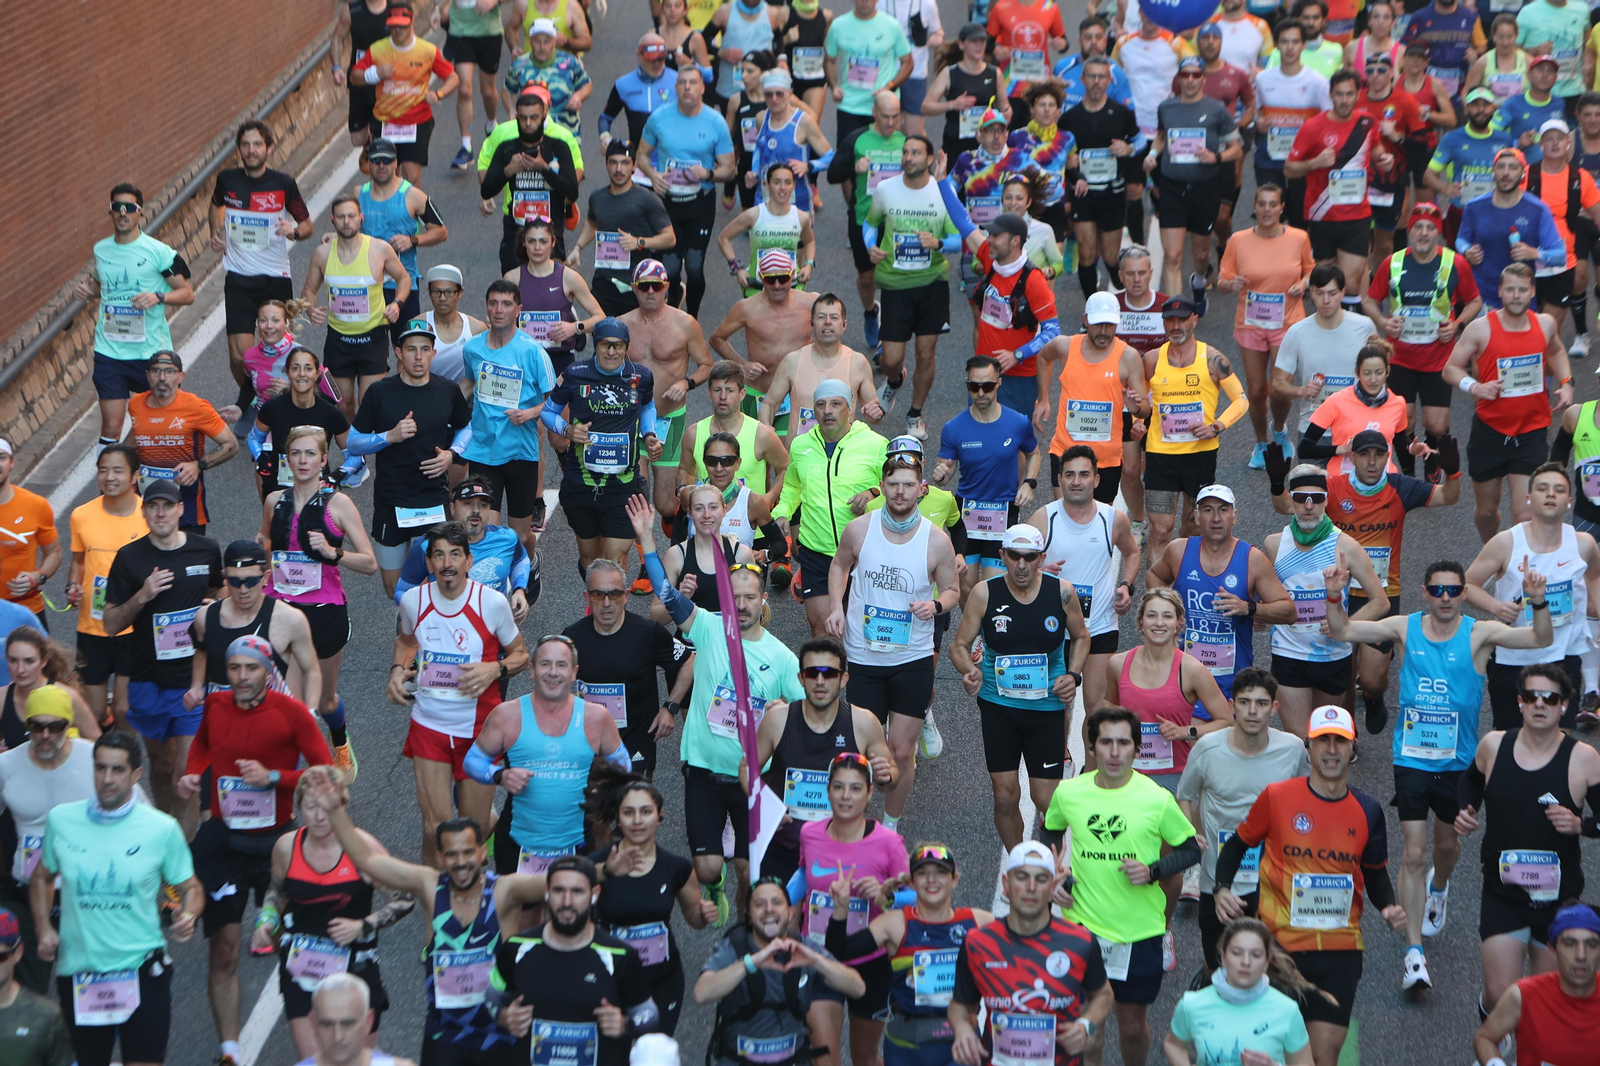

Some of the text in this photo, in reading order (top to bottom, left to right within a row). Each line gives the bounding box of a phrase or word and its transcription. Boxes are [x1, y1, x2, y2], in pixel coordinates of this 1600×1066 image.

[244, 217, 265, 226] ZURICH
[341, 288, 363, 296] ZURICH
[116, 307, 140, 315] ZURICH
[1512, 357, 1538, 366] ZURICH
[495, 368, 518, 378] ZURICH
[150, 470, 174, 478] ZURICH
[1358, 519, 1397, 532] CAMAS
[880, 564, 899, 574] THE
[864, 570, 898, 583] NORTH
[872, 580, 898, 591] FACE
[1546, 584, 1568, 593] URICH
[879, 611, 906, 620] ZURICH
[876, 626, 894, 634] 5652
[436, 655, 464, 664] ZURICH
[1417, 677, 1448, 694] 26
[1420, 715, 1450, 724] ZURICH
[1420, 730, 1438, 738] 5374
[804, 791, 822, 799] 4279
[1087, 852, 1106, 860] POR
[1283, 844, 1358, 864] CDA CAMA
[1520, 854, 1552, 862] ZURICH
[1314, 878, 1346, 887] ZURICH
[1012, 1020, 1046, 1028] ZURICH
